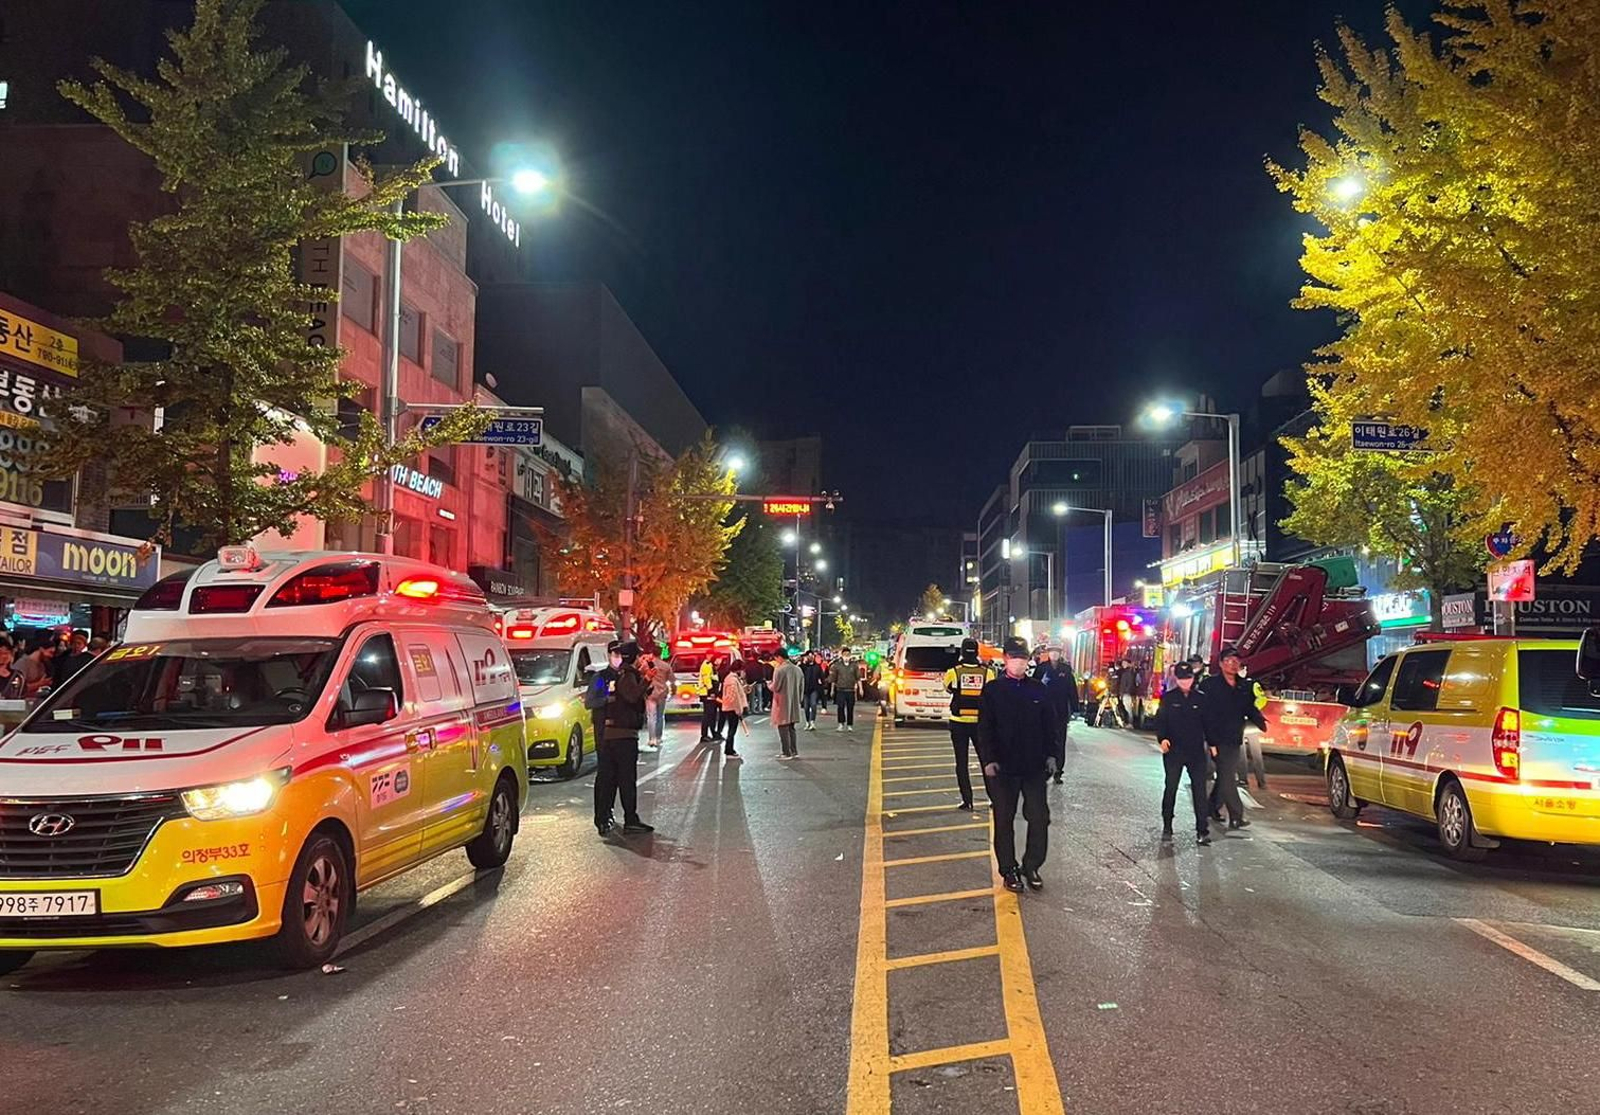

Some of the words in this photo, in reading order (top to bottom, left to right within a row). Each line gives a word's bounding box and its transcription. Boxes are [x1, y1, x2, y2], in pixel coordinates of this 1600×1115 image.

[366, 40, 459, 177] Hamilton
[480, 180, 520, 247] Hotel
[409, 470, 442, 499] BEACH
[62, 542, 137, 578] moon
[1484, 600, 1591, 614] HUSTON
[1388, 720, 1423, 760] 119
[182, 844, 251, 864] 의정부33호
[43, 895, 88, 913] 7917
